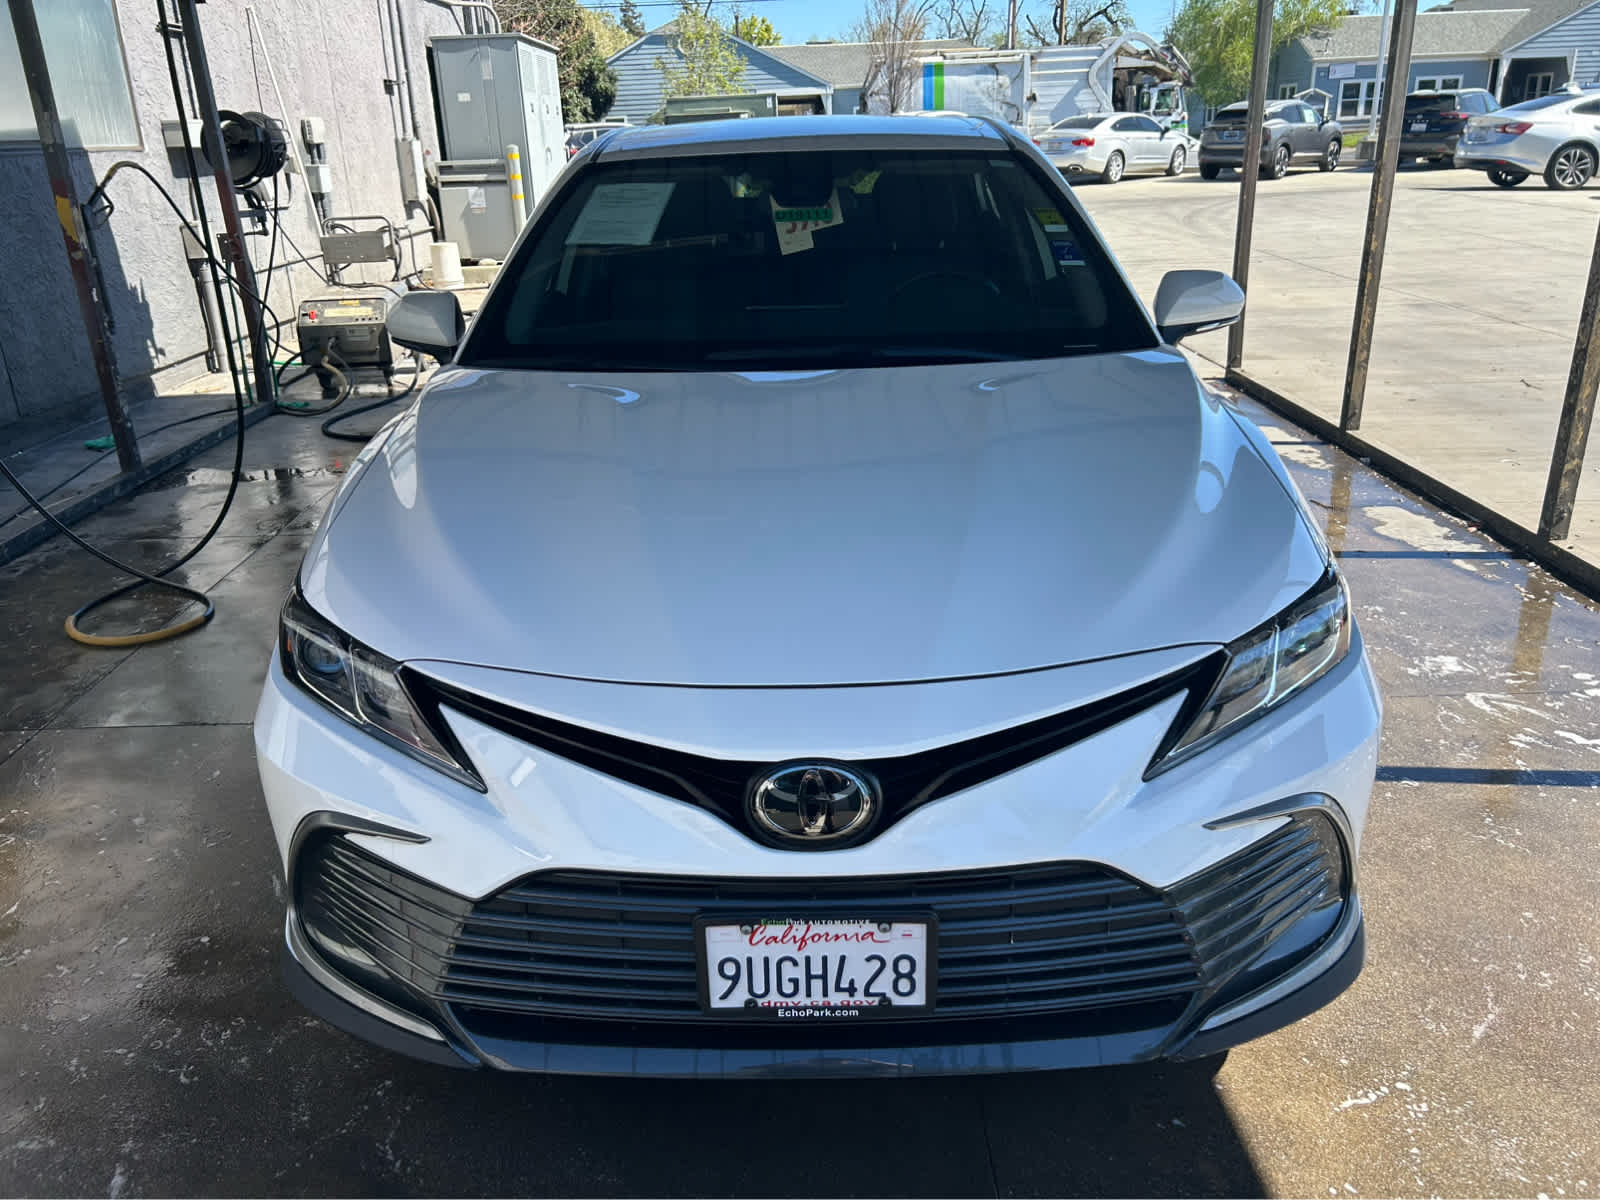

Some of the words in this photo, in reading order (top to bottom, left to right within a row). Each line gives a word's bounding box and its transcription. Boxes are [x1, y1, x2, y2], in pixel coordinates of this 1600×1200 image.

[749, 924, 890, 951] California
[717, 954, 917, 1000] 9UGH428
[761, 999, 876, 1007] dmv.ca.gov
[777, 1008, 859, 1017] EchoPark.com
